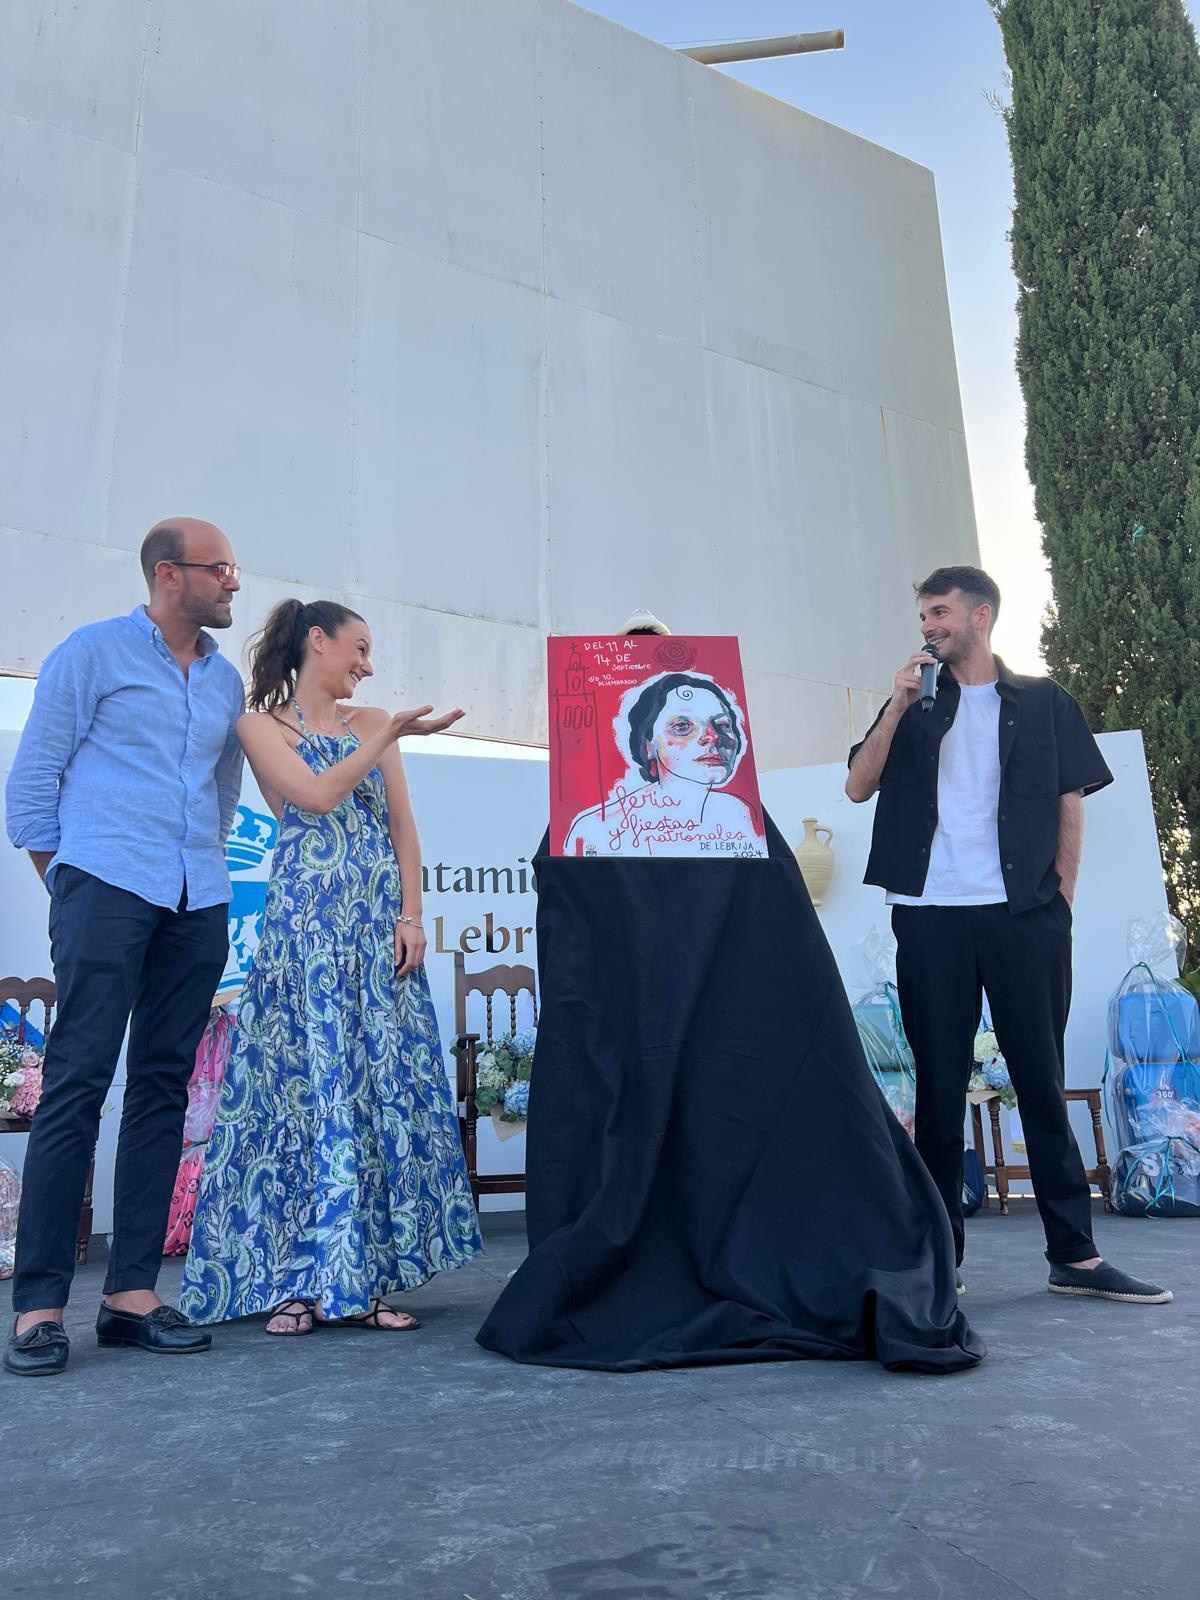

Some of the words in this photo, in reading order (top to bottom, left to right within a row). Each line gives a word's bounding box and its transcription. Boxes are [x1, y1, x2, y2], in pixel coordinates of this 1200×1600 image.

[584, 641, 604, 651] DEL
[605, 641, 619, 652] 11
[623, 640, 637, 650] AL
[593, 653, 611, 666] 14
[615, 654, 631, 662] DE
[608, 826, 626, 851] y
[629, 813, 700, 848] fiestas
[644, 823, 748, 856] patronales
[700, 841, 711, 851] DE
[715, 841, 754, 851] LEBRIJA
[733, 850, 764, 858] 2024
